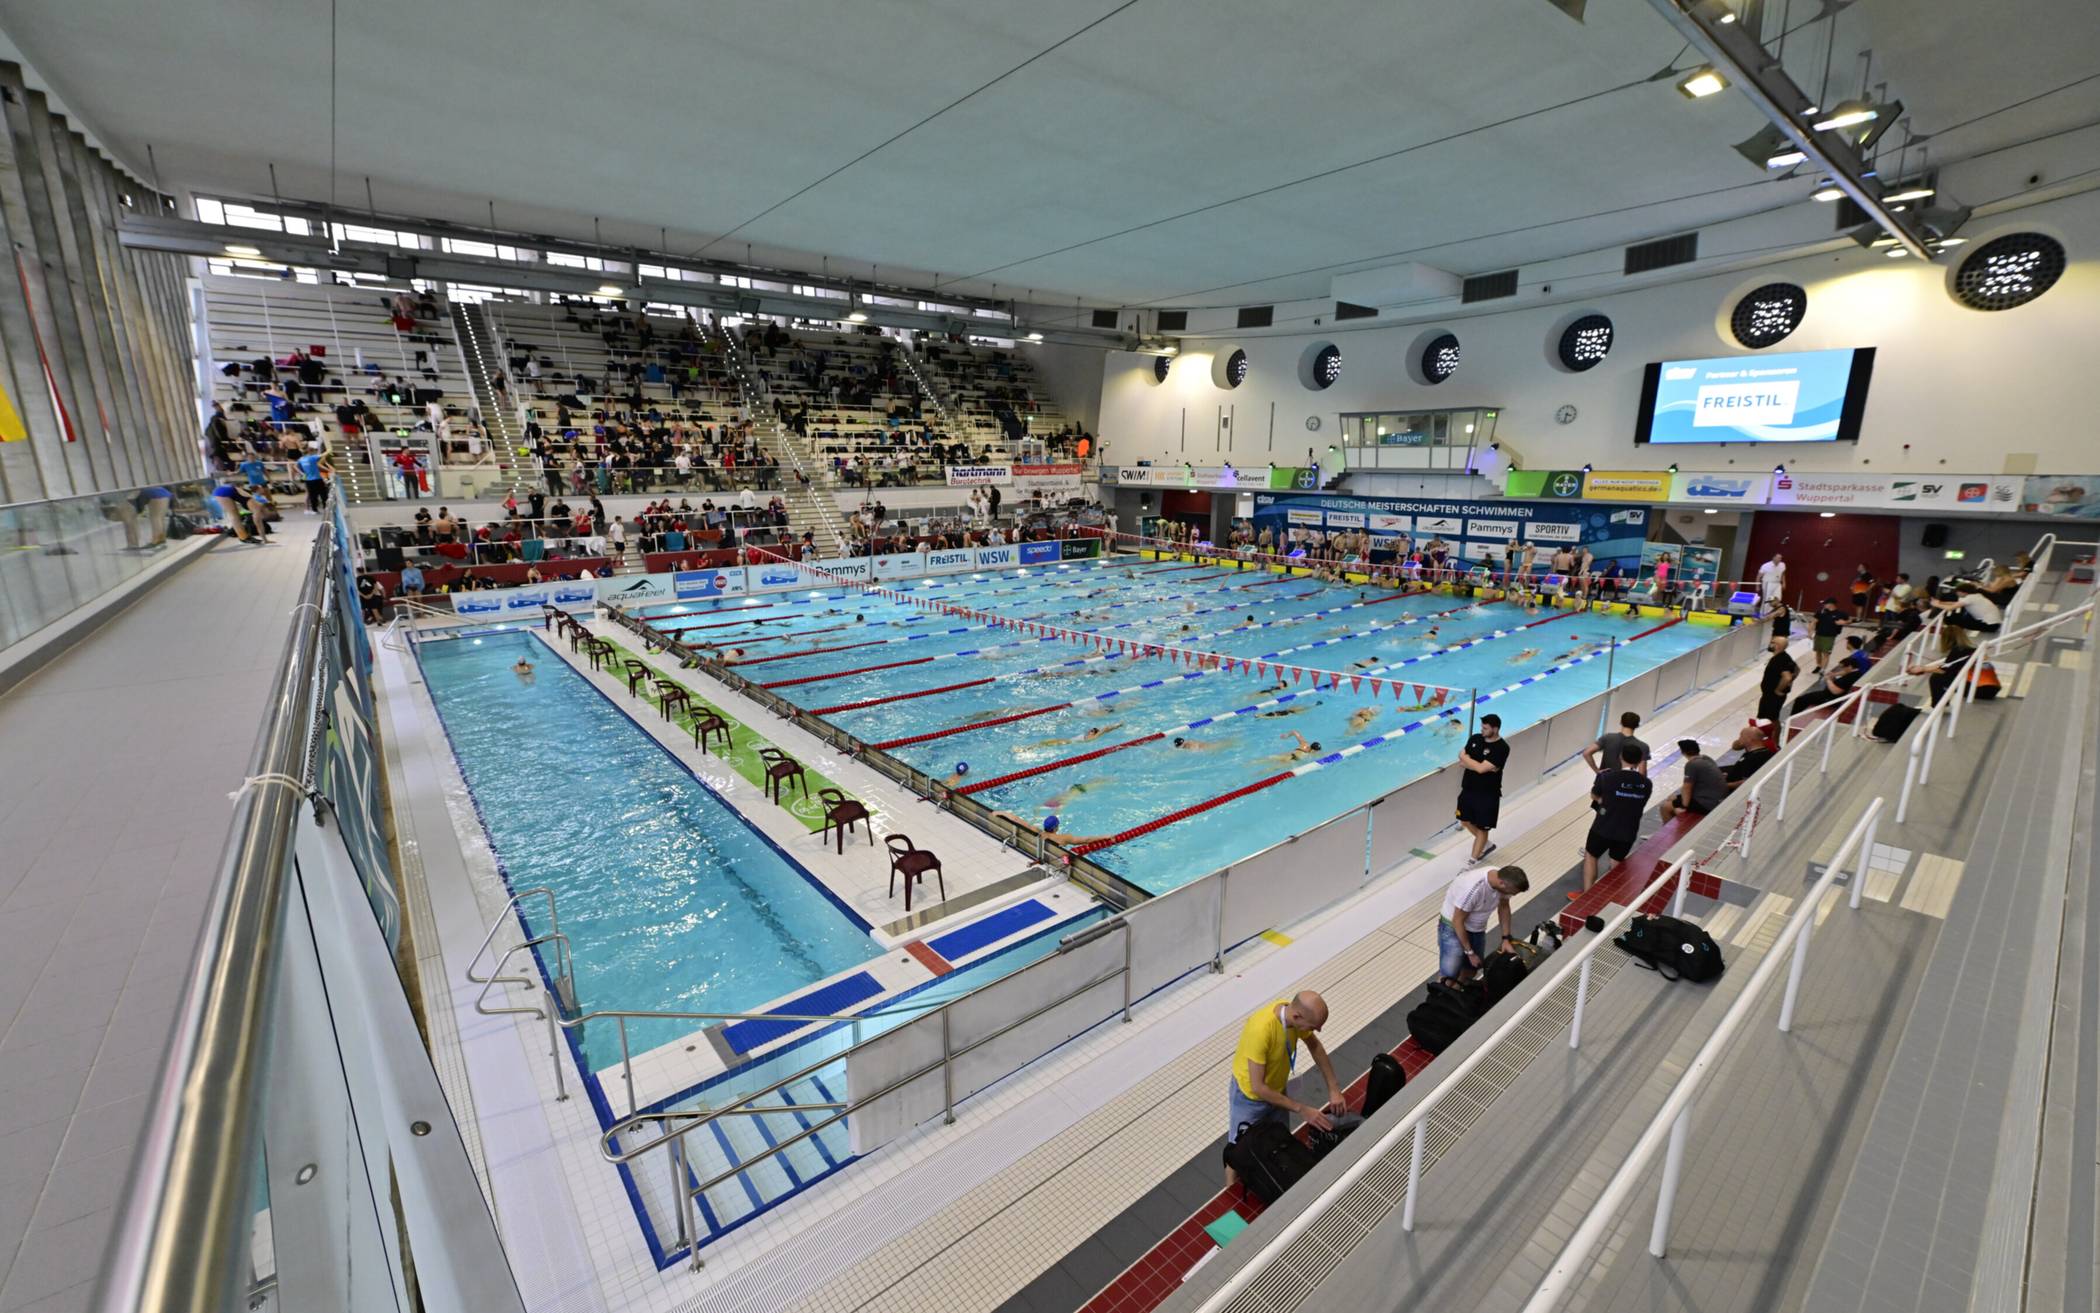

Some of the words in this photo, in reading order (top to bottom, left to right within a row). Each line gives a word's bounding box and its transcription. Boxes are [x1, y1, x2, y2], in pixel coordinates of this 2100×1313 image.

[1703, 394, 1782, 409] FREISTIL
[1396, 434, 1422, 444] Bayer
[952, 466, 1006, 477] hartmann
[1798, 482, 1885, 493] Stadtsparkasse
[1796, 493, 1854, 503] Wuppertal
[1321, 500, 1366, 509] DEUTSCHE
[1367, 502, 1460, 514] MEISTERSCHAFTEN
[1462, 505, 1534, 517] SCHWIMMEN
[1470, 523, 1513, 534] Pammys
[1535, 524, 1570, 535] SPORTIV
[1027, 545, 1052, 554] speedo
[1073, 545, 1086, 554] Bayer
[979, 550, 1010, 564] WSW
[608, 589, 666, 601] aquafeel
